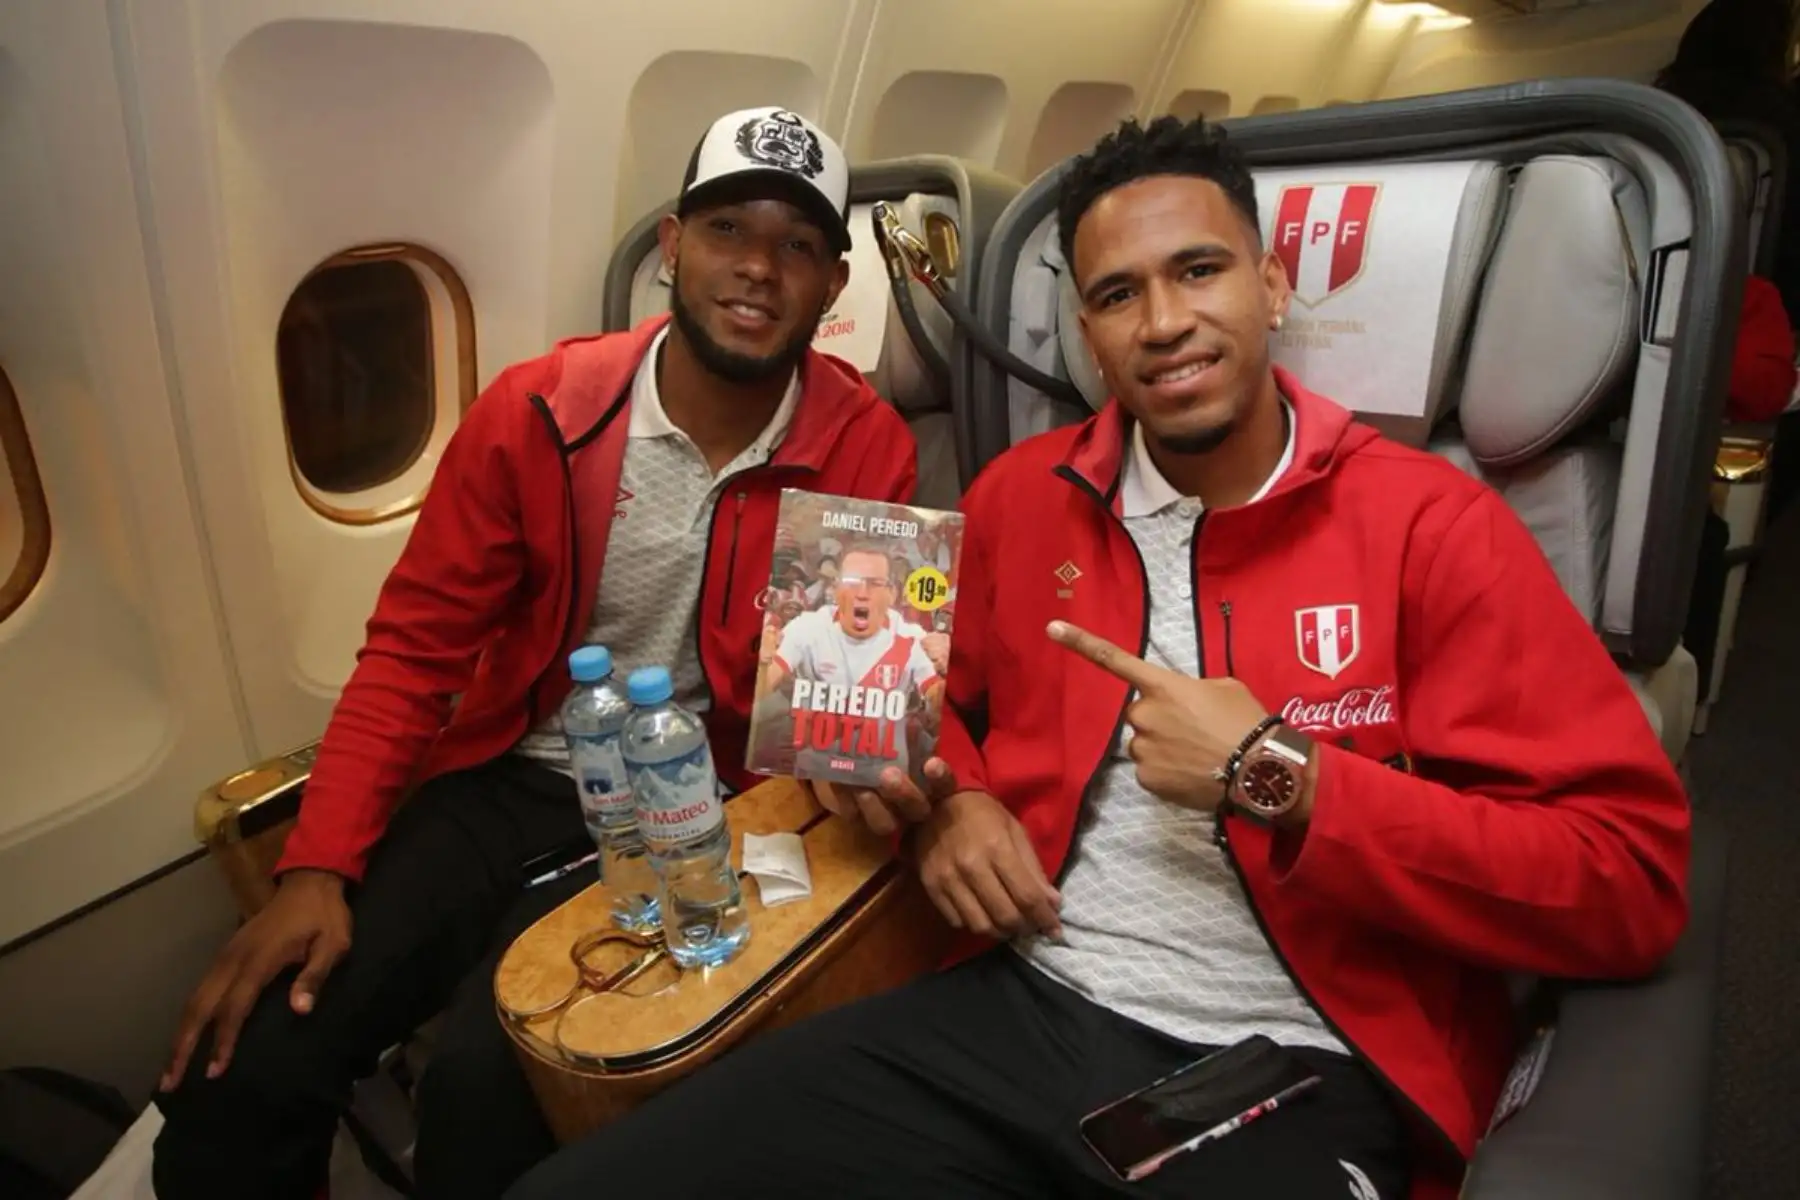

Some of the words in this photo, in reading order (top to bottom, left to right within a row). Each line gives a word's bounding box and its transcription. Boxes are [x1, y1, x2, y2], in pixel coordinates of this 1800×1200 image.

[822, 510, 867, 532] DANIEL
[869, 516, 919, 539] PEREDO
[792, 678, 906, 721] PEREDO
[791, 707, 899, 759] TOTAL
[653, 801, 709, 825] Mateo
